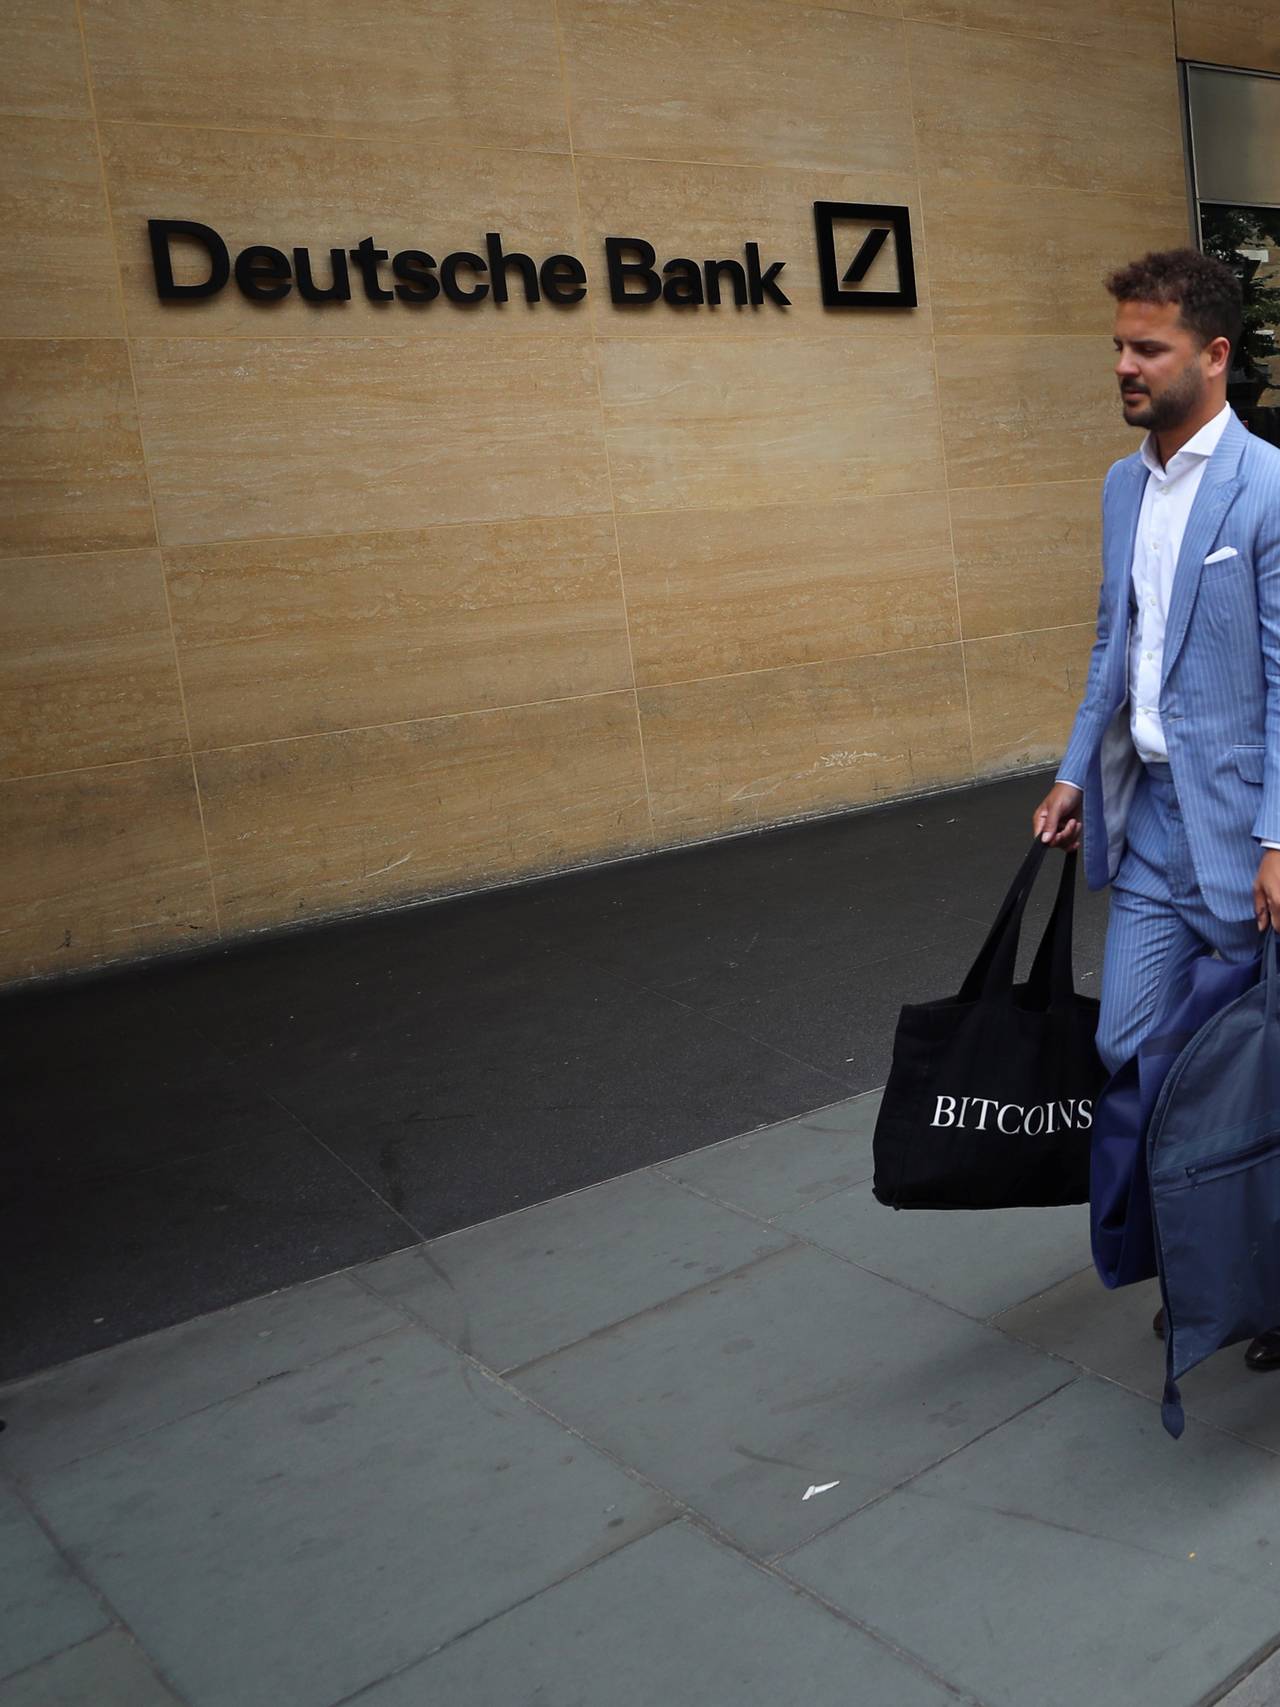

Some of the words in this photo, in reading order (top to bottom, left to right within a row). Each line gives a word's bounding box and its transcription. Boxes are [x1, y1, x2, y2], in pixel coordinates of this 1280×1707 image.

[148, 219, 588, 305] Deutsche
[605, 237, 792, 306] Bank
[930, 1095, 1093, 1136] BITCOINS
